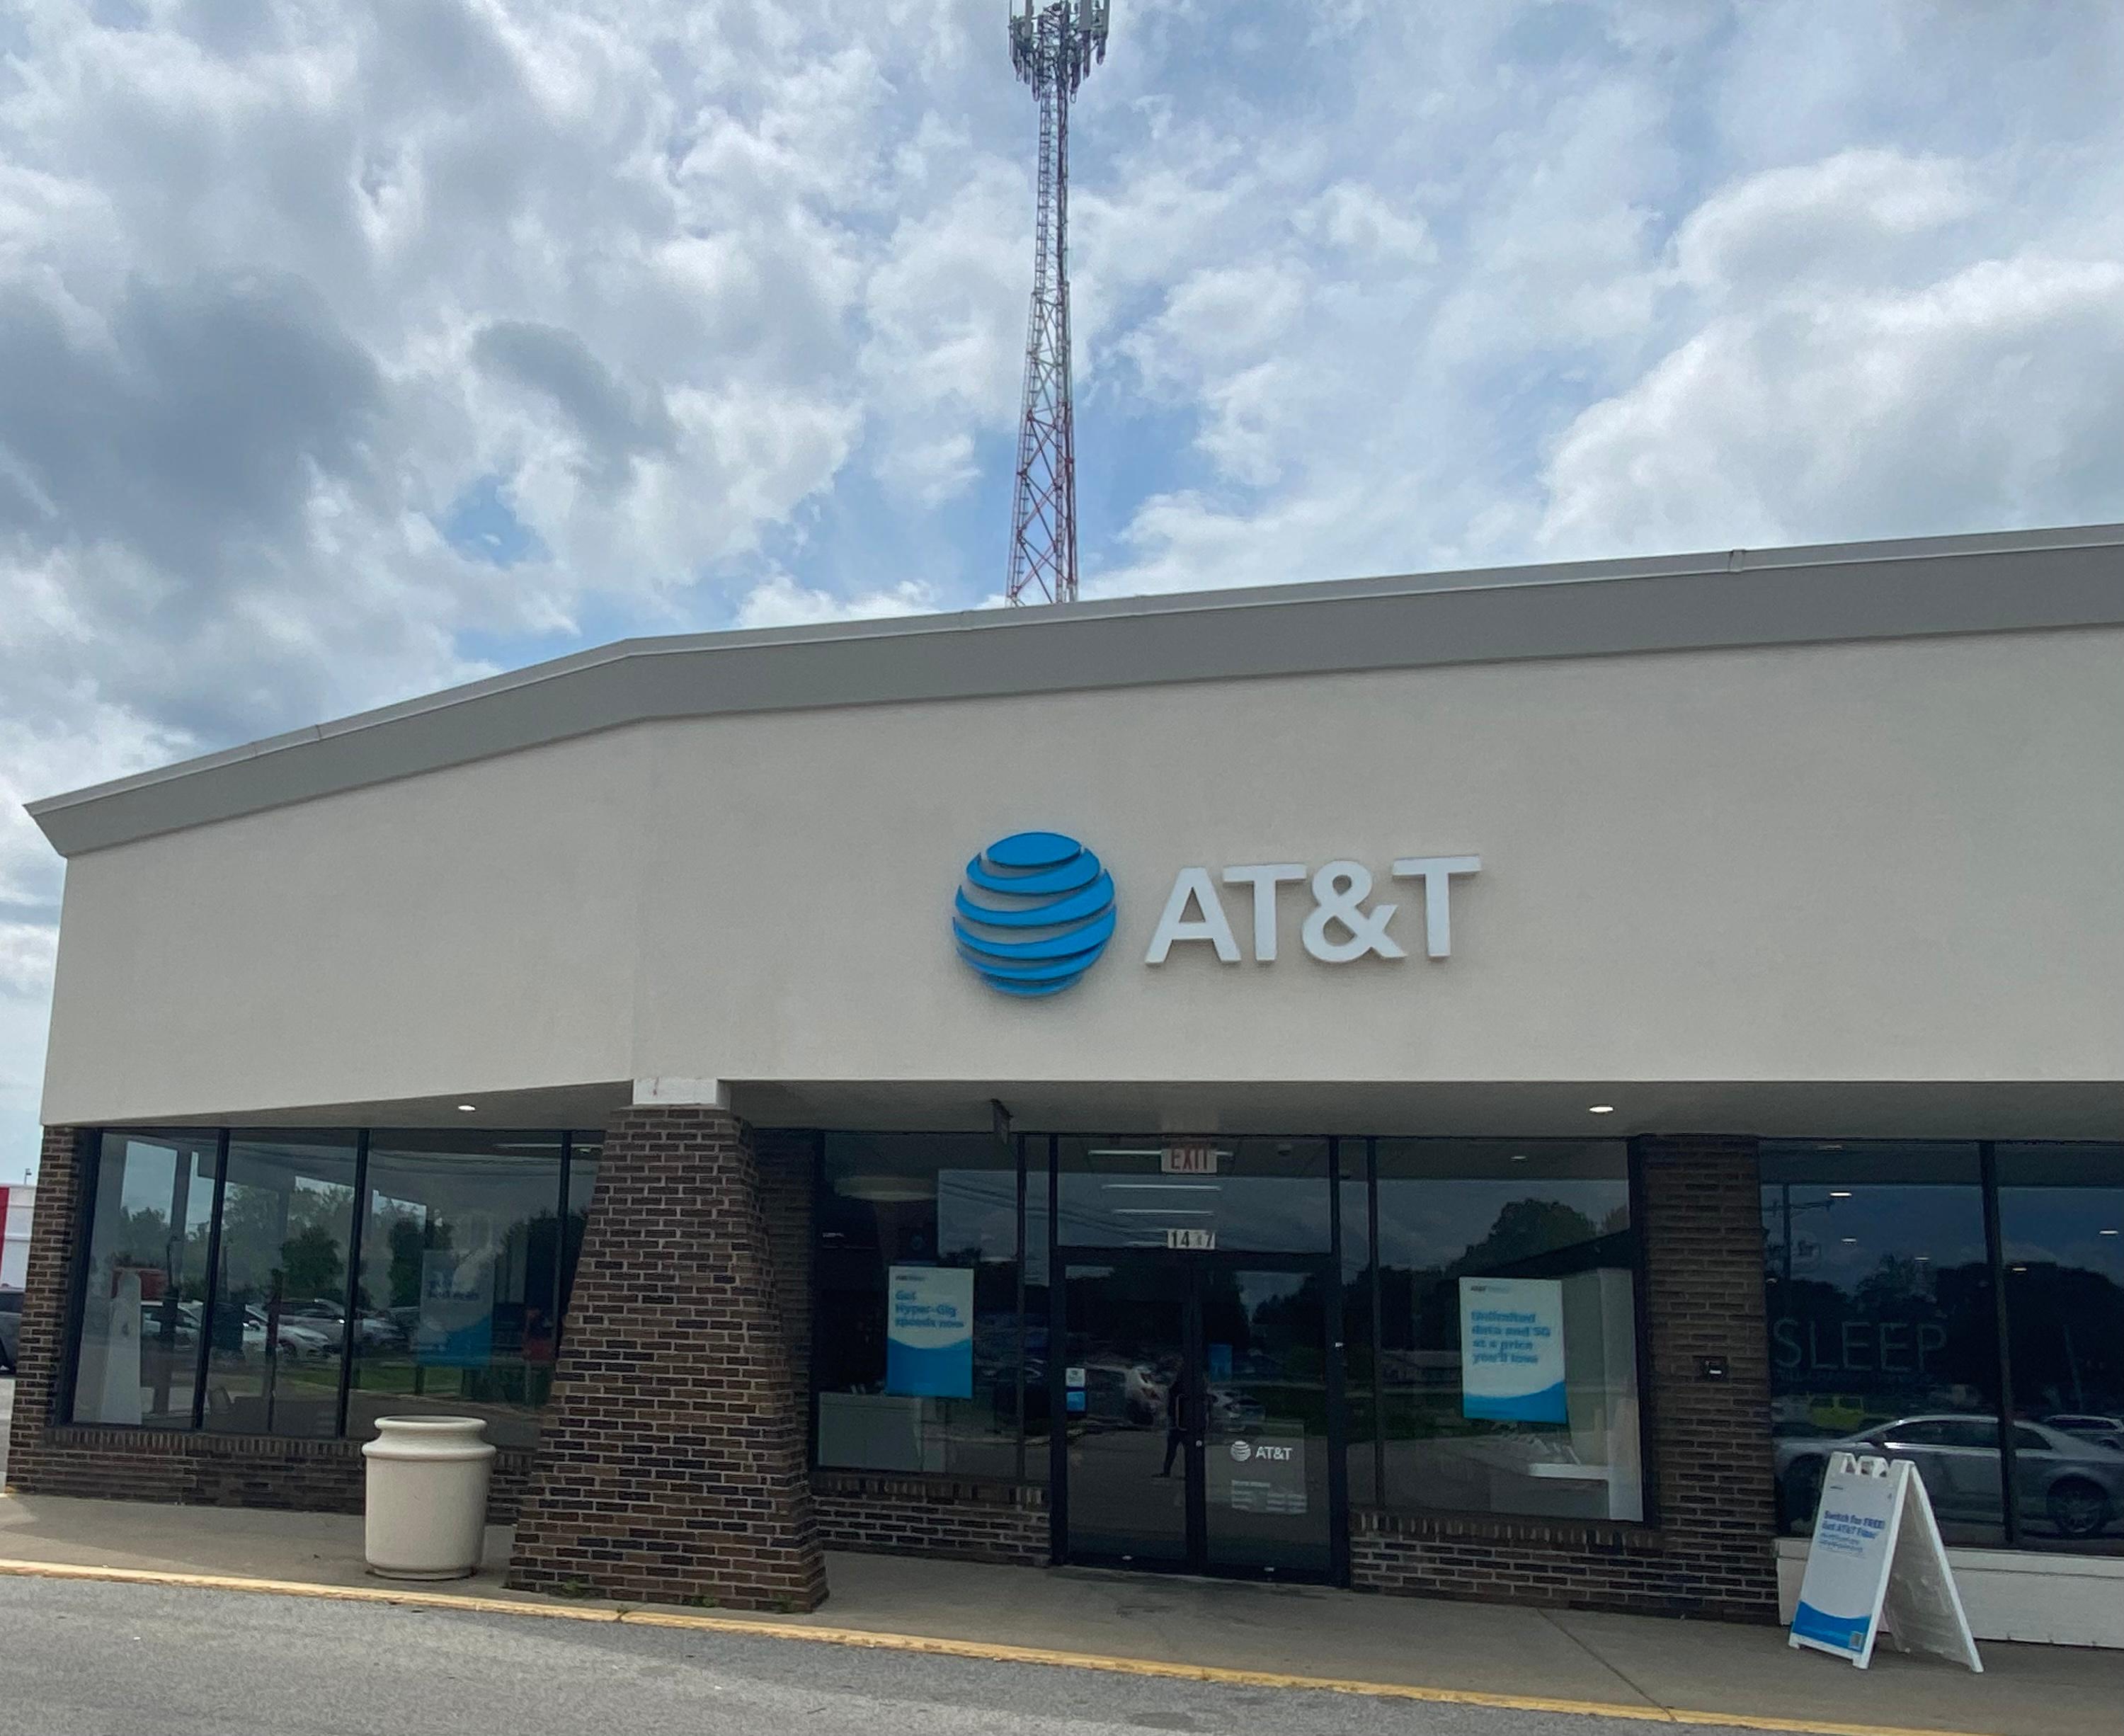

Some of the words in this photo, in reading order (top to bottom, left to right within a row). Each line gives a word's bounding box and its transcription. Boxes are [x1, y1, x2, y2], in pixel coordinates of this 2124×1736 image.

[1145, 855, 1482, 964] AT&T
[1171, 1148, 1209, 1170] EXIT
[1471, 1310, 1536, 1323] Unlimited
[1472, 1325, 1502, 1335] data
[1505, 1326, 1529, 1337] and
[1500, 1340, 1533, 1352] price
[1773, 1318, 1948, 1372] SLEEP
[1255, 1446, 1292, 1461] AT&T
